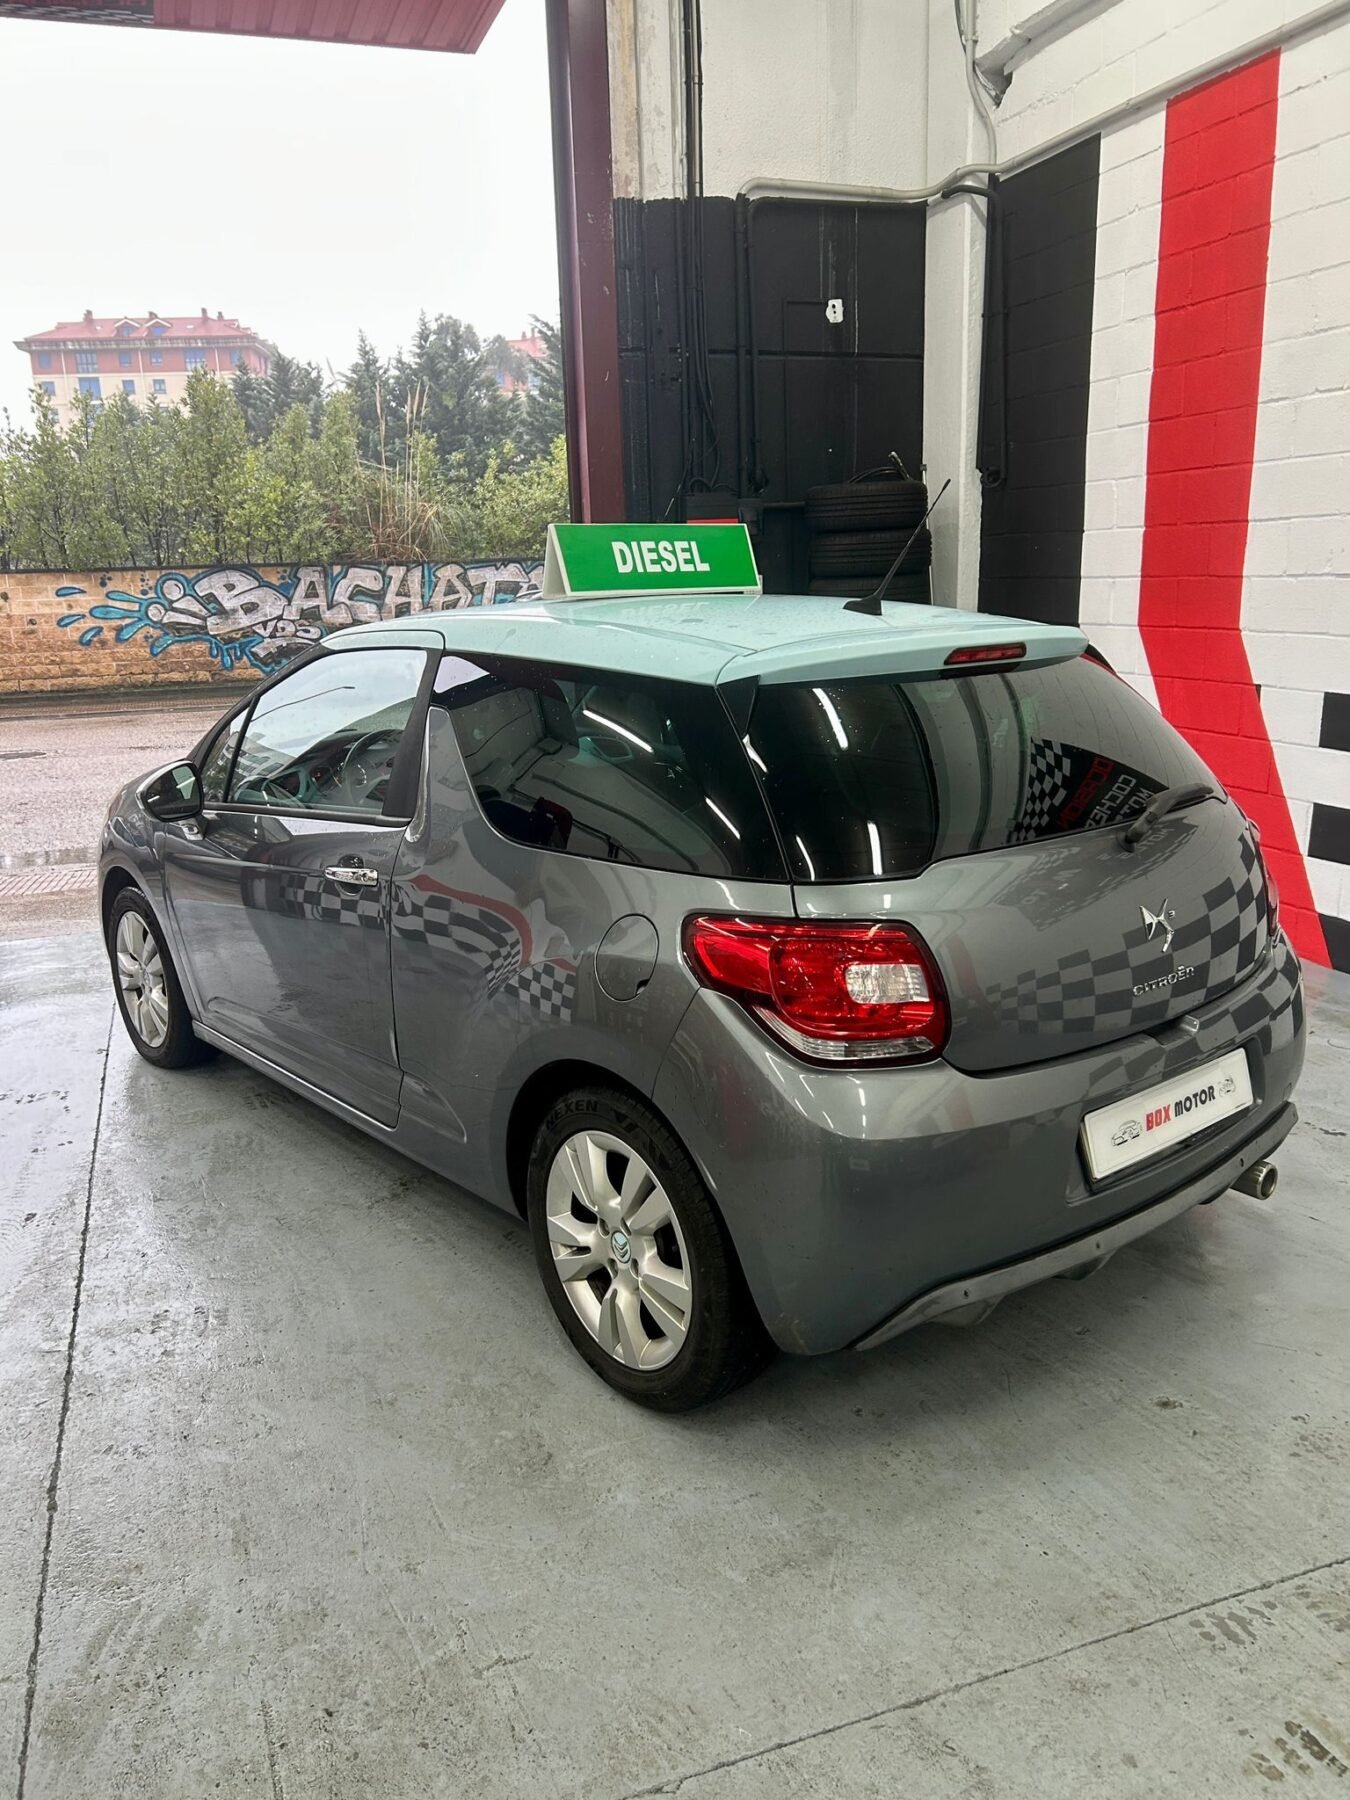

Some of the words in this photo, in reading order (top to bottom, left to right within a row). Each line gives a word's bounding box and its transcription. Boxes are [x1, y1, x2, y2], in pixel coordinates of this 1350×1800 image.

[611, 541, 710, 573] DIESEL
[545, 1099, 599, 1131] NEXEN
[1145, 1104, 1172, 1132] BOX
[1174, 1085, 1216, 1118] MOTOR
